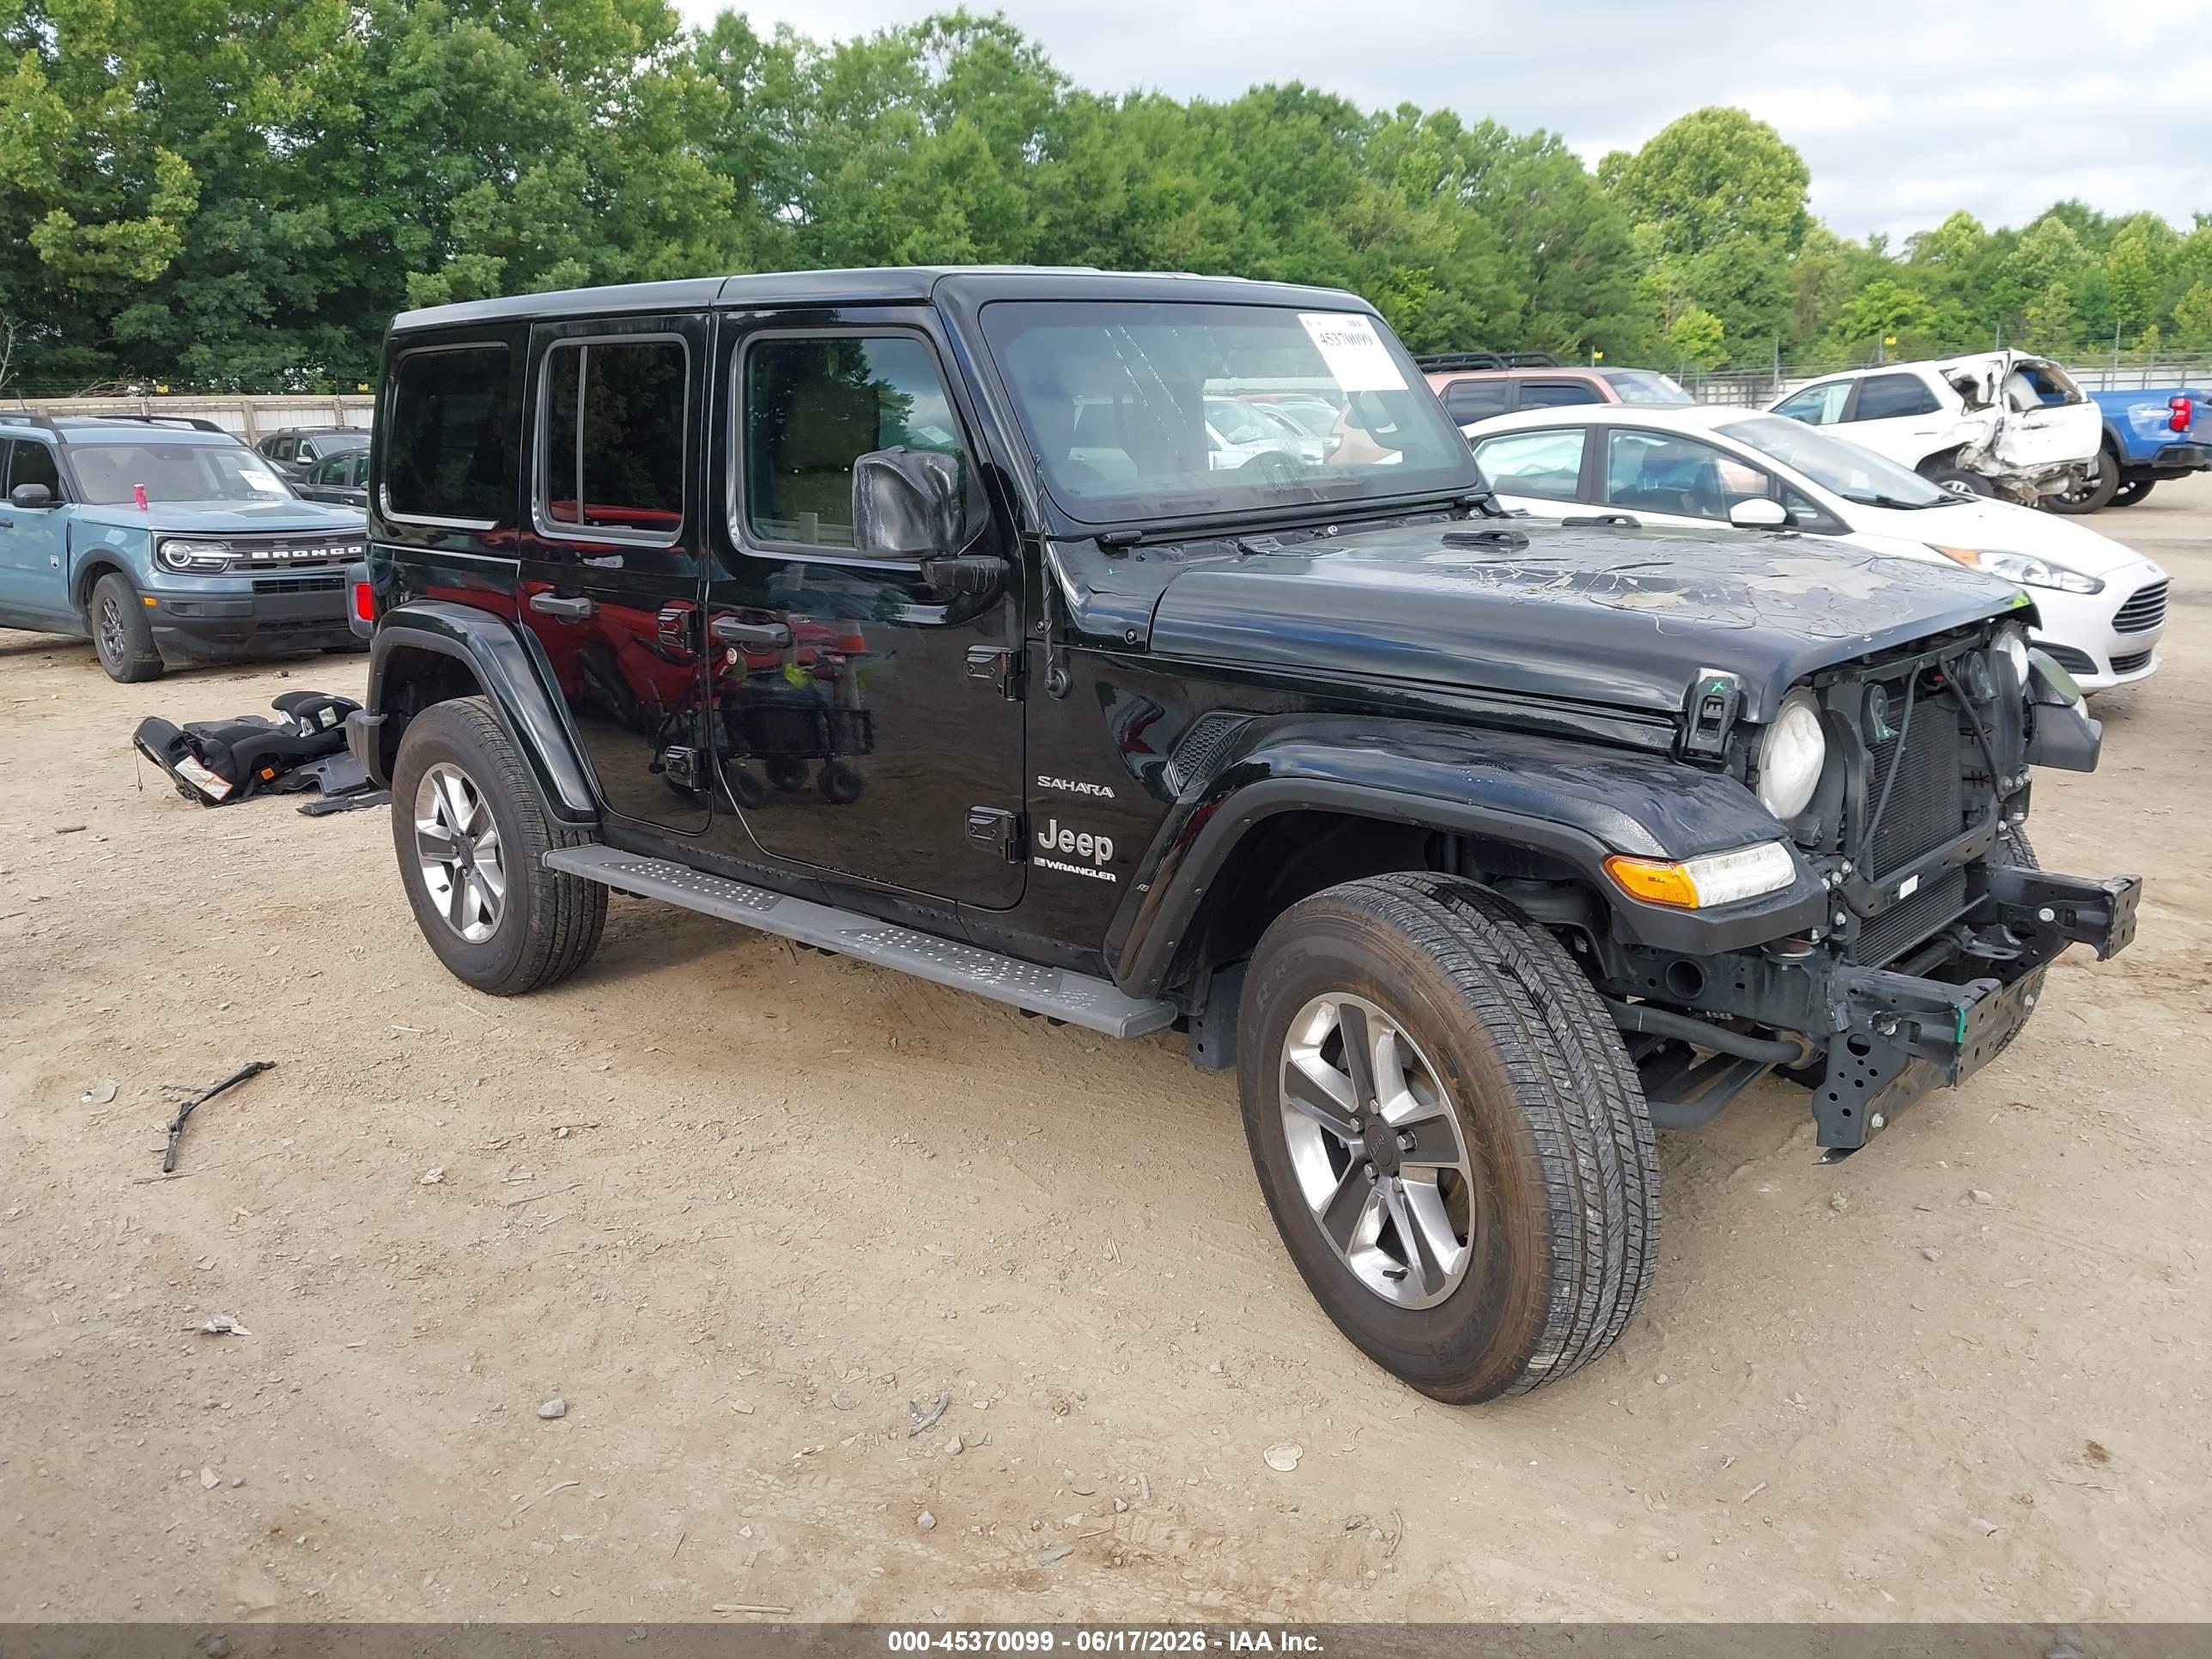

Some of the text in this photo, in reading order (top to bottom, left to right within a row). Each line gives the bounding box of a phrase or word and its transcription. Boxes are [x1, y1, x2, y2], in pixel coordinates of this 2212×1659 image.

[252, 546, 362, 559] BRONCO
[1037, 775, 1115, 799] SAHARA
[1038, 818, 1114, 866] Jeep
[1045, 859, 1117, 883] WRANGLER
